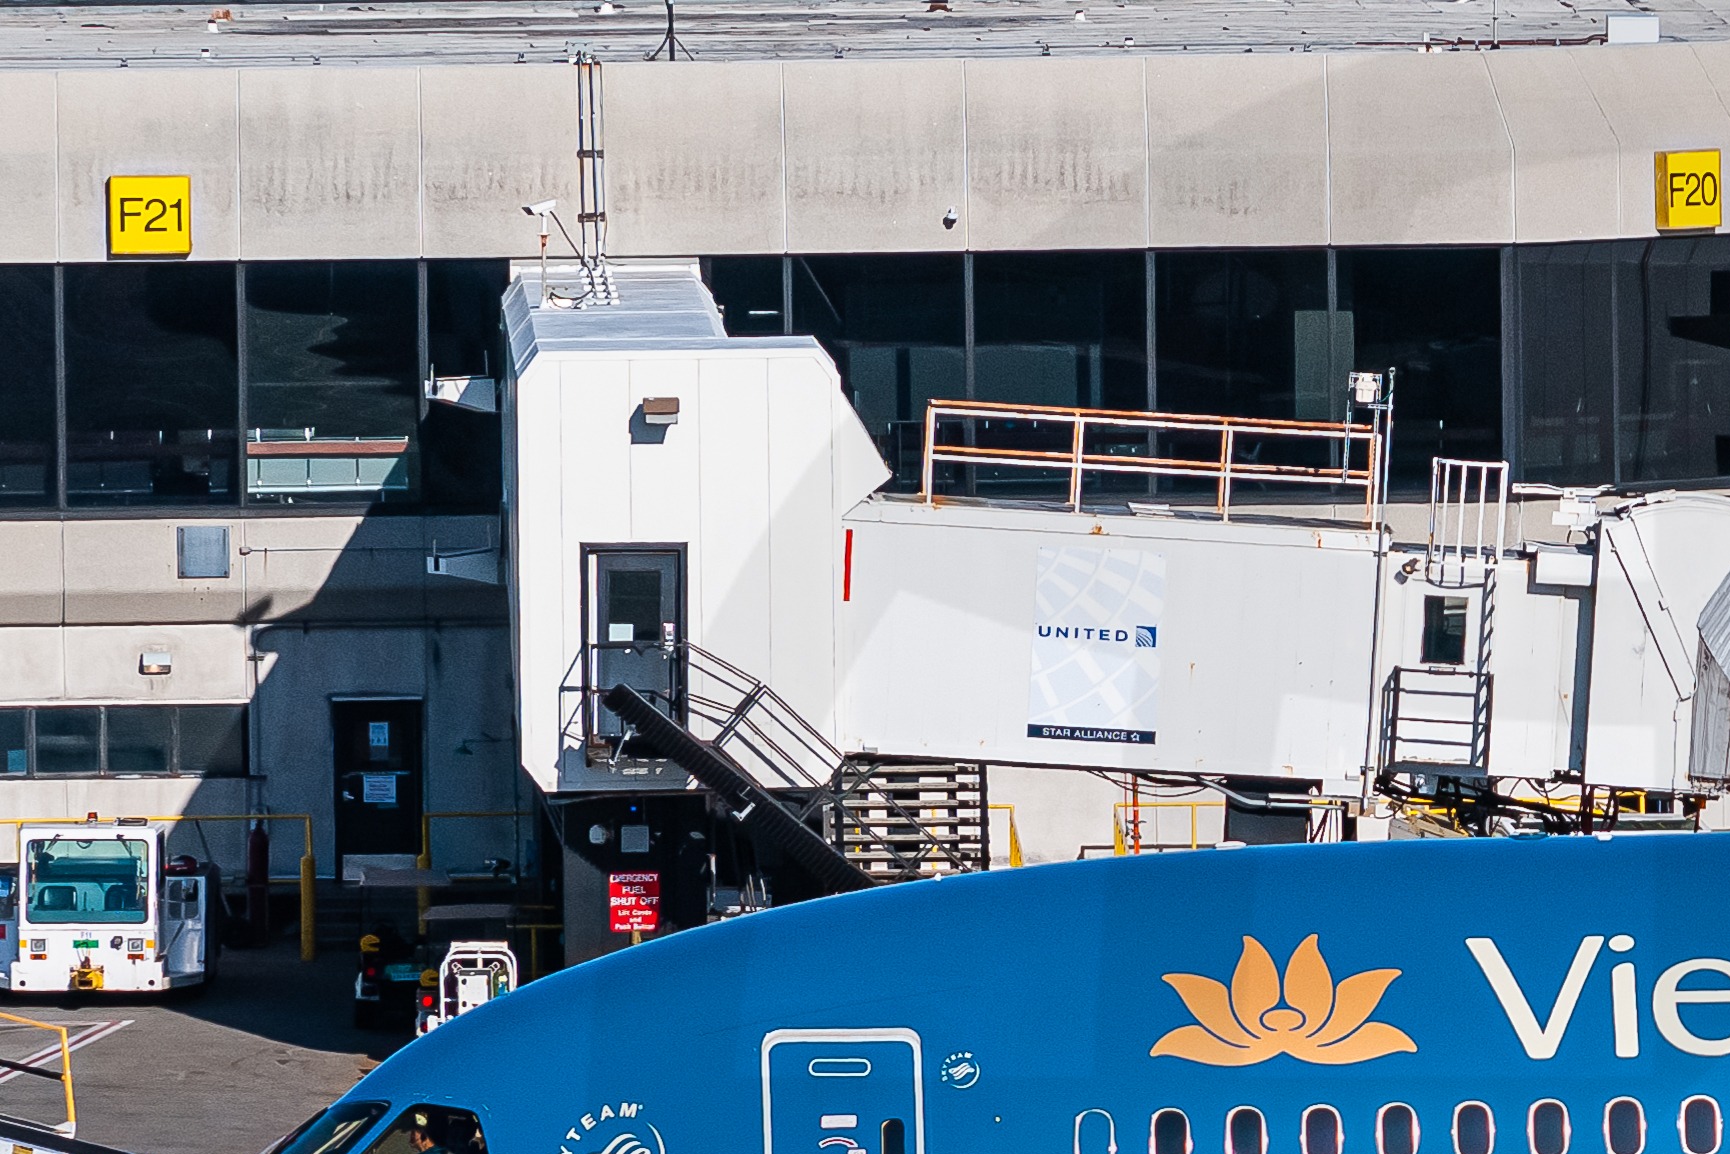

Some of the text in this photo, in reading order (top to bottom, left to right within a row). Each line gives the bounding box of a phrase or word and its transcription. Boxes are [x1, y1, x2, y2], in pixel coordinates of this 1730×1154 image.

[1669, 171, 1718, 208] F20
[119, 197, 182, 232] F21
[1038, 625, 1129, 642] UNITED
[1042, 727, 1128, 741] STAR ALLIANCE
[609, 873, 658, 883] EMERGENCY
[622, 886, 646, 894] FUEL
[610, 896, 659, 906] SHUT OFF
